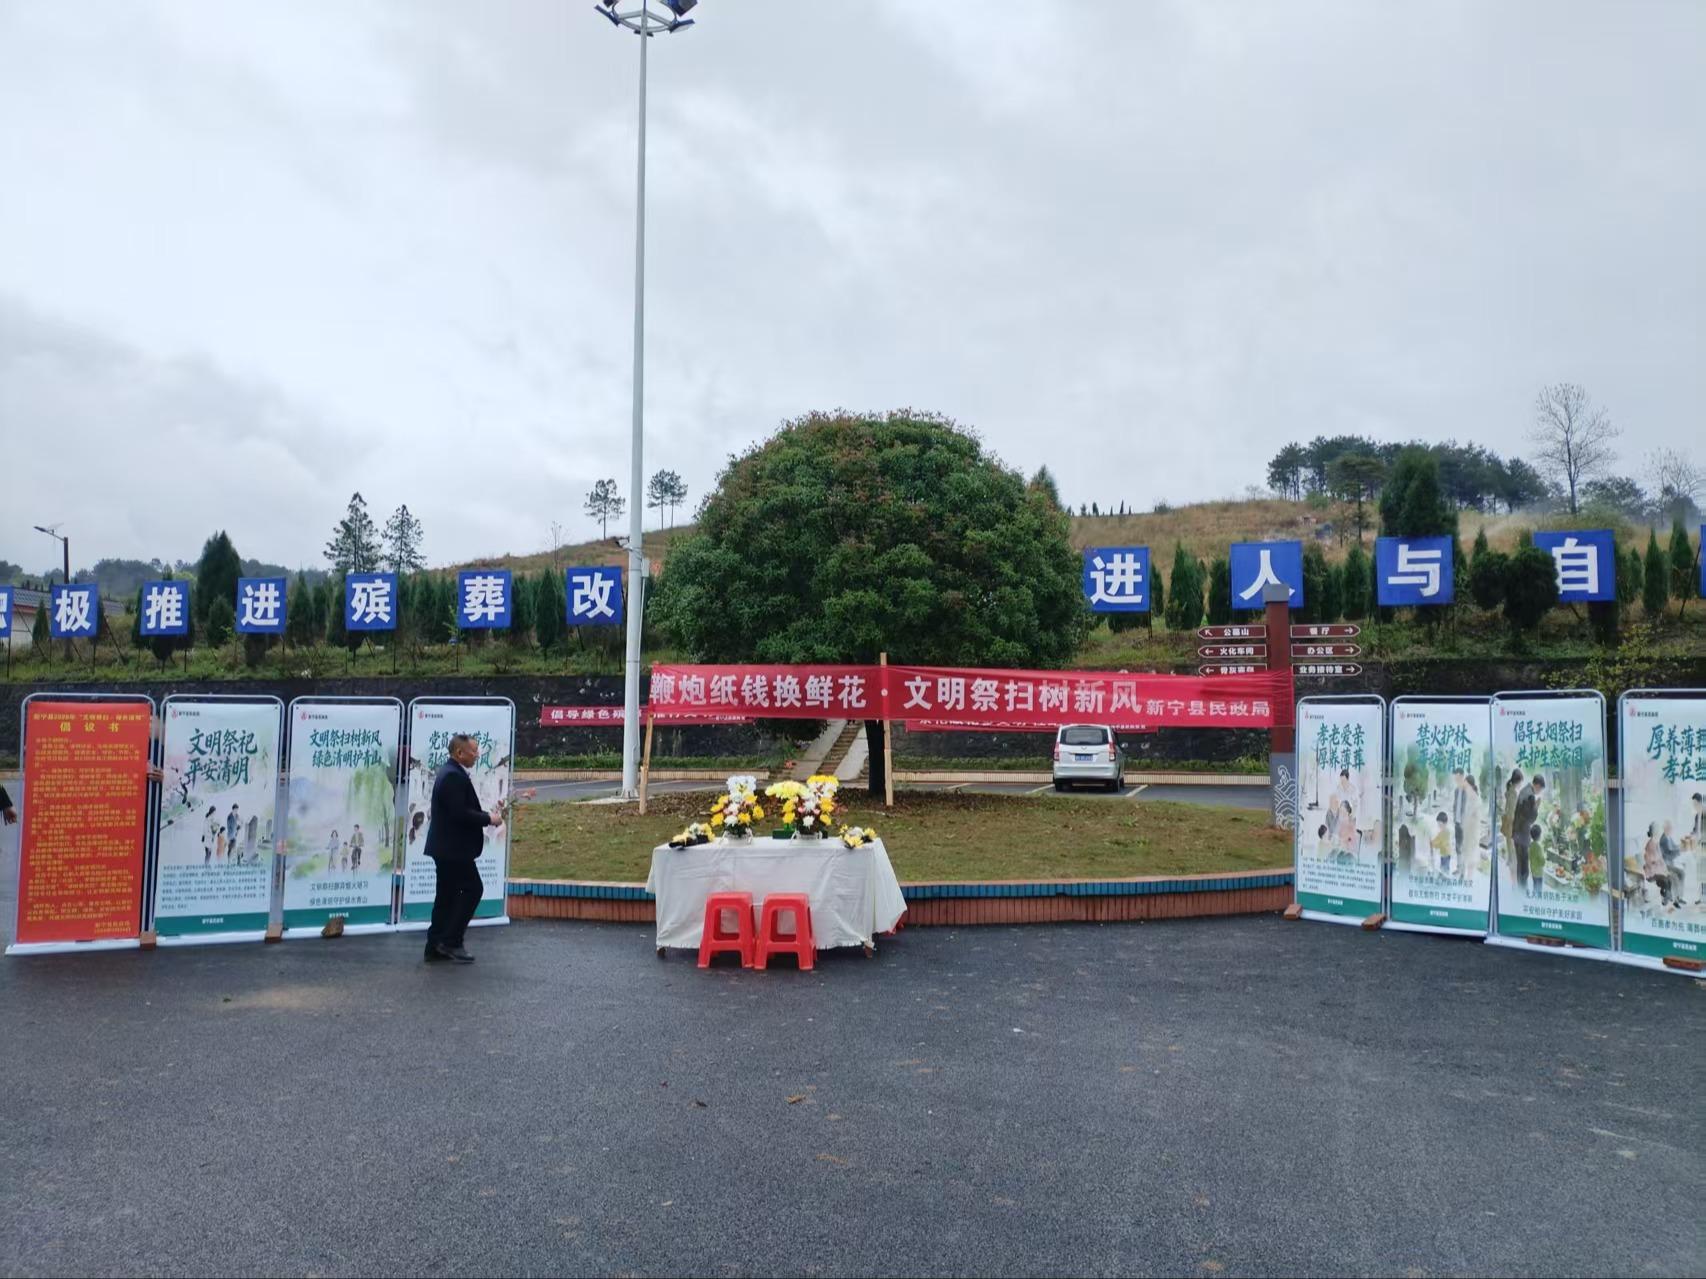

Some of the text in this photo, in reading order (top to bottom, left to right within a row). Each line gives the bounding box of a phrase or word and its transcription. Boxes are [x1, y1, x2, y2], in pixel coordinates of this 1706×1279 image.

[1090, 553, 1142, 604] 进
[1239, 550, 1295, 600] 人
[1388, 544, 1442, 597] 与
[1552, 537, 1598, 594] 自
[55, 590, 91, 632] 极
[146, 586, 183, 629] 推
[242, 583, 280, 626] 进
[351, 579, 391, 624] 殡
[464, 575, 505, 622] 葬
[573, 572, 615, 618] 改
[1220, 645, 1254, 655] 火化车间
[1307, 647, 1333, 655] 办公区
[1299, 666, 1343, 674] 业务接待室
[903, 676, 1142, 714] 文明祭扫树新风
[1146, 700, 1270, 717] 新宁县民政局
[187, 728, 257, 756] 文明祭祀
[310, 729, 382, 747] 文明祭扫树新风
[1317, 723, 1365, 746] 孝老爱亲
[1416, 722, 1472, 748] 禁火护林
[1514, 720, 1583, 744] 倡导无烟祭扫
[184, 756, 249, 789] 平安清明
[312, 748, 382, 768] 绿色清明护青山
[1319, 747, 1366, 772] 厚养薄葬
[1515, 745, 1583, 769] 共护生态家园
